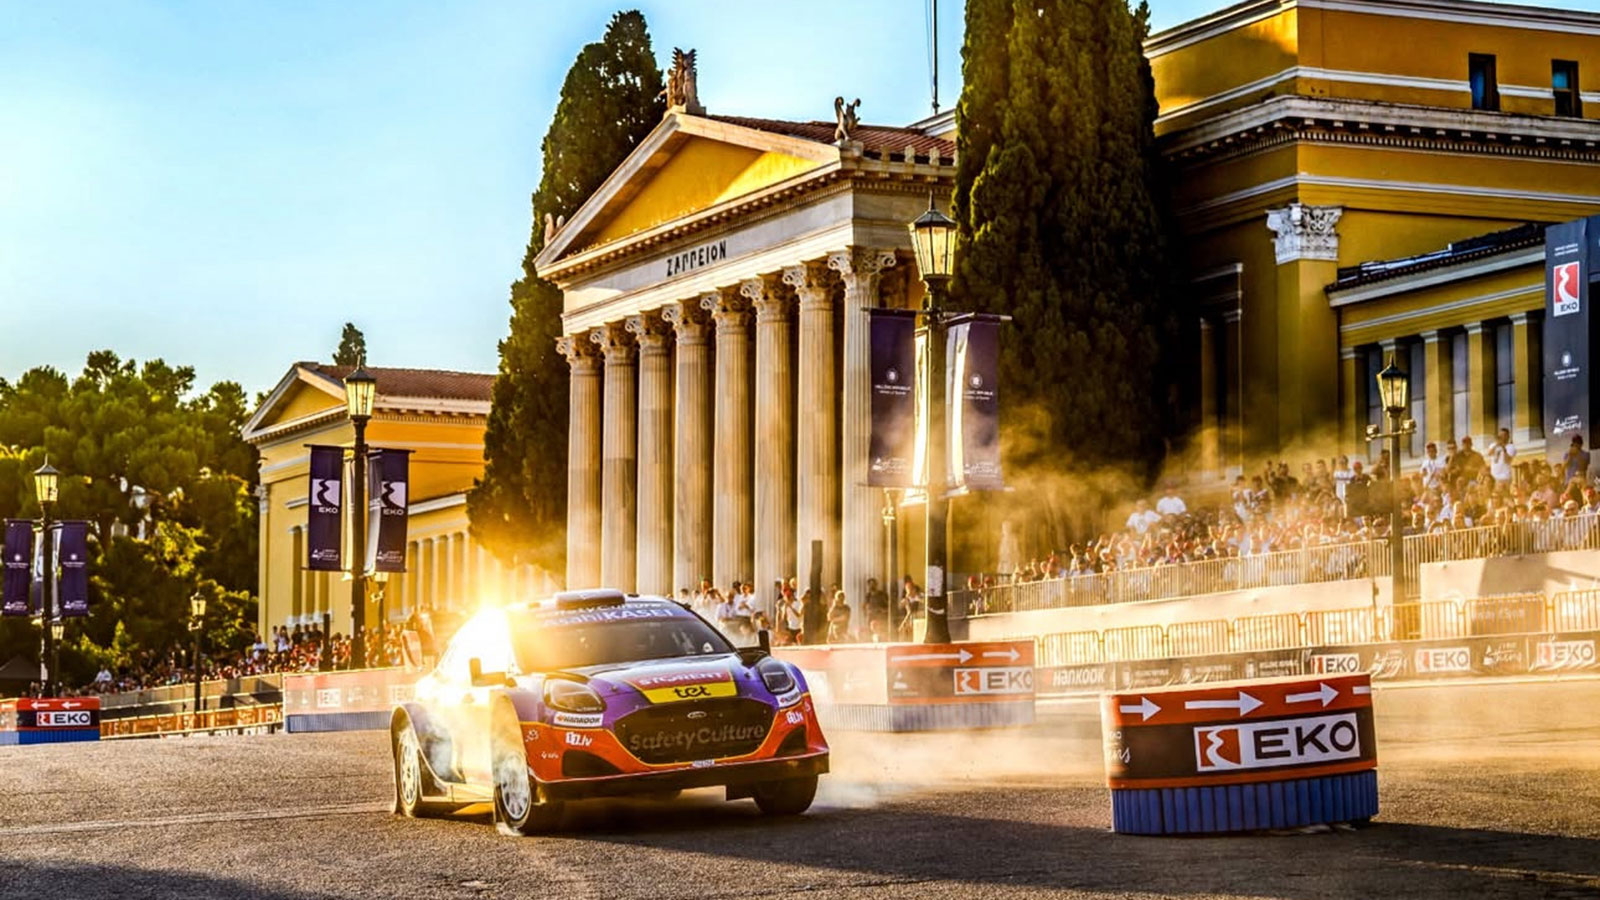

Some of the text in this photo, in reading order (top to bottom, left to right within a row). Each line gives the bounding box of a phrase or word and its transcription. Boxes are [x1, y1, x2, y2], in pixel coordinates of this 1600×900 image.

[1560, 301, 1578, 312] EKO
[318, 506, 339, 515] EKO
[382, 508, 404, 516] EKO
[1433, 650, 1469, 668] EKO
[1554, 643, 1594, 662] EKO
[1325, 655, 1359, 673] EKO
[674, 686, 711, 698] tet
[54, 712, 91, 724] EKO
[630, 724, 764, 750] SafetyCulture
[1253, 720, 1357, 760] EKO
